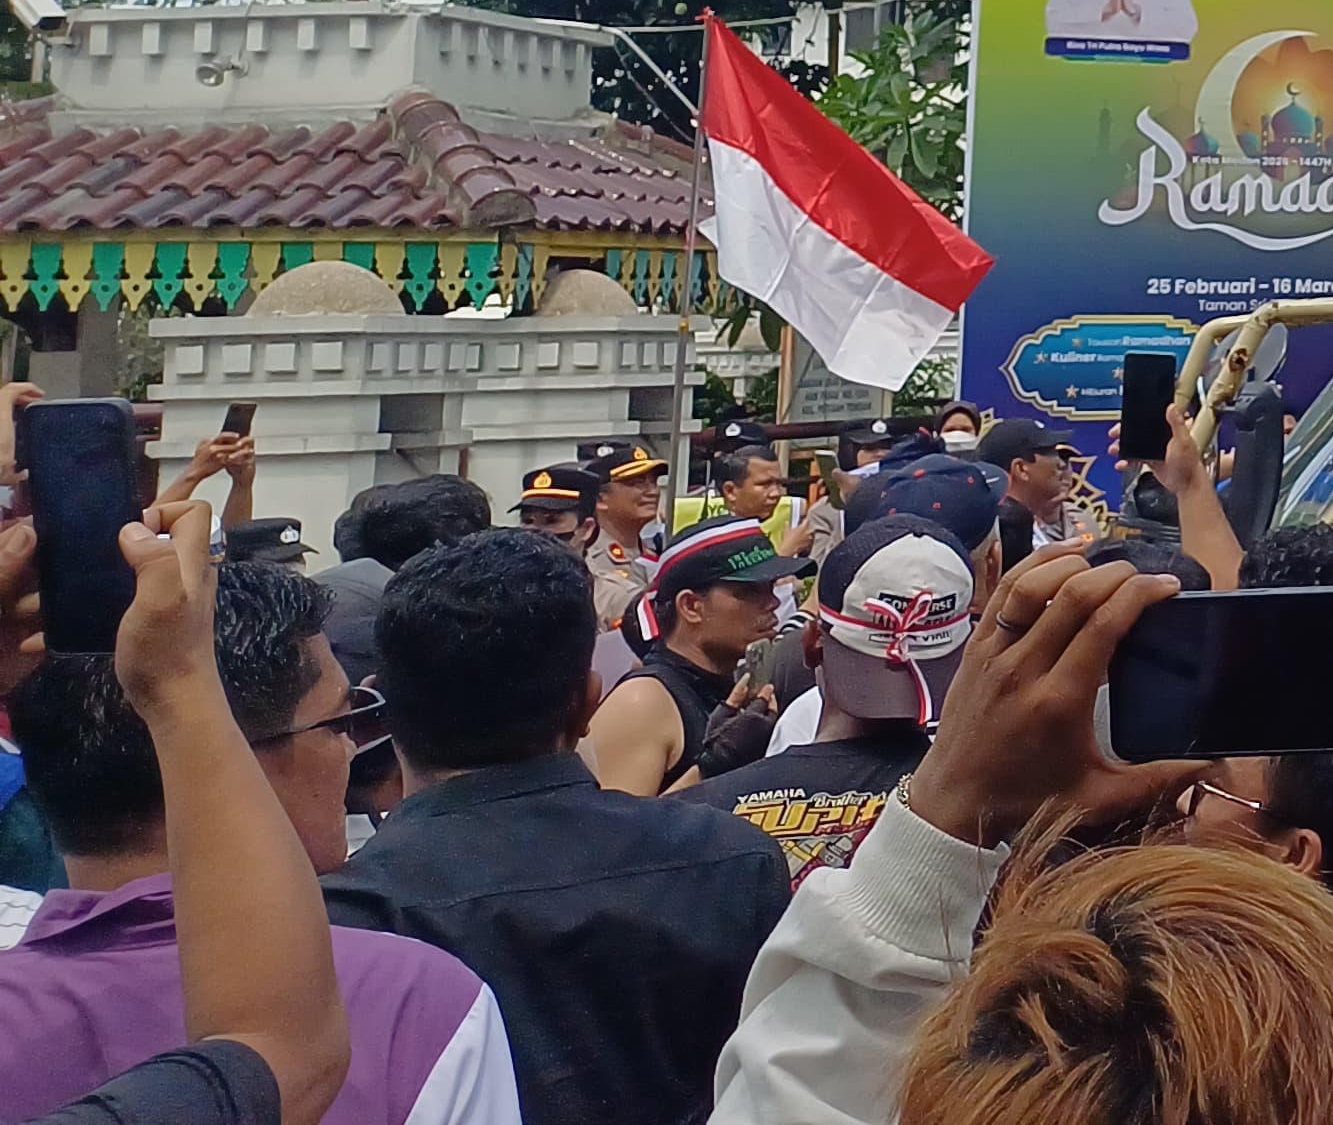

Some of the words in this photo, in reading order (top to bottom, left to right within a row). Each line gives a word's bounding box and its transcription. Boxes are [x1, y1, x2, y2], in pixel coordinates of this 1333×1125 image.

[1147, 279, 1171, 295] 25
[1174, 277, 1255, 295] Februari
[1272, 278, 1291, 294] 16
[1199, 299, 1247, 312] Taman
[737, 788, 806, 804] YAMAHA
